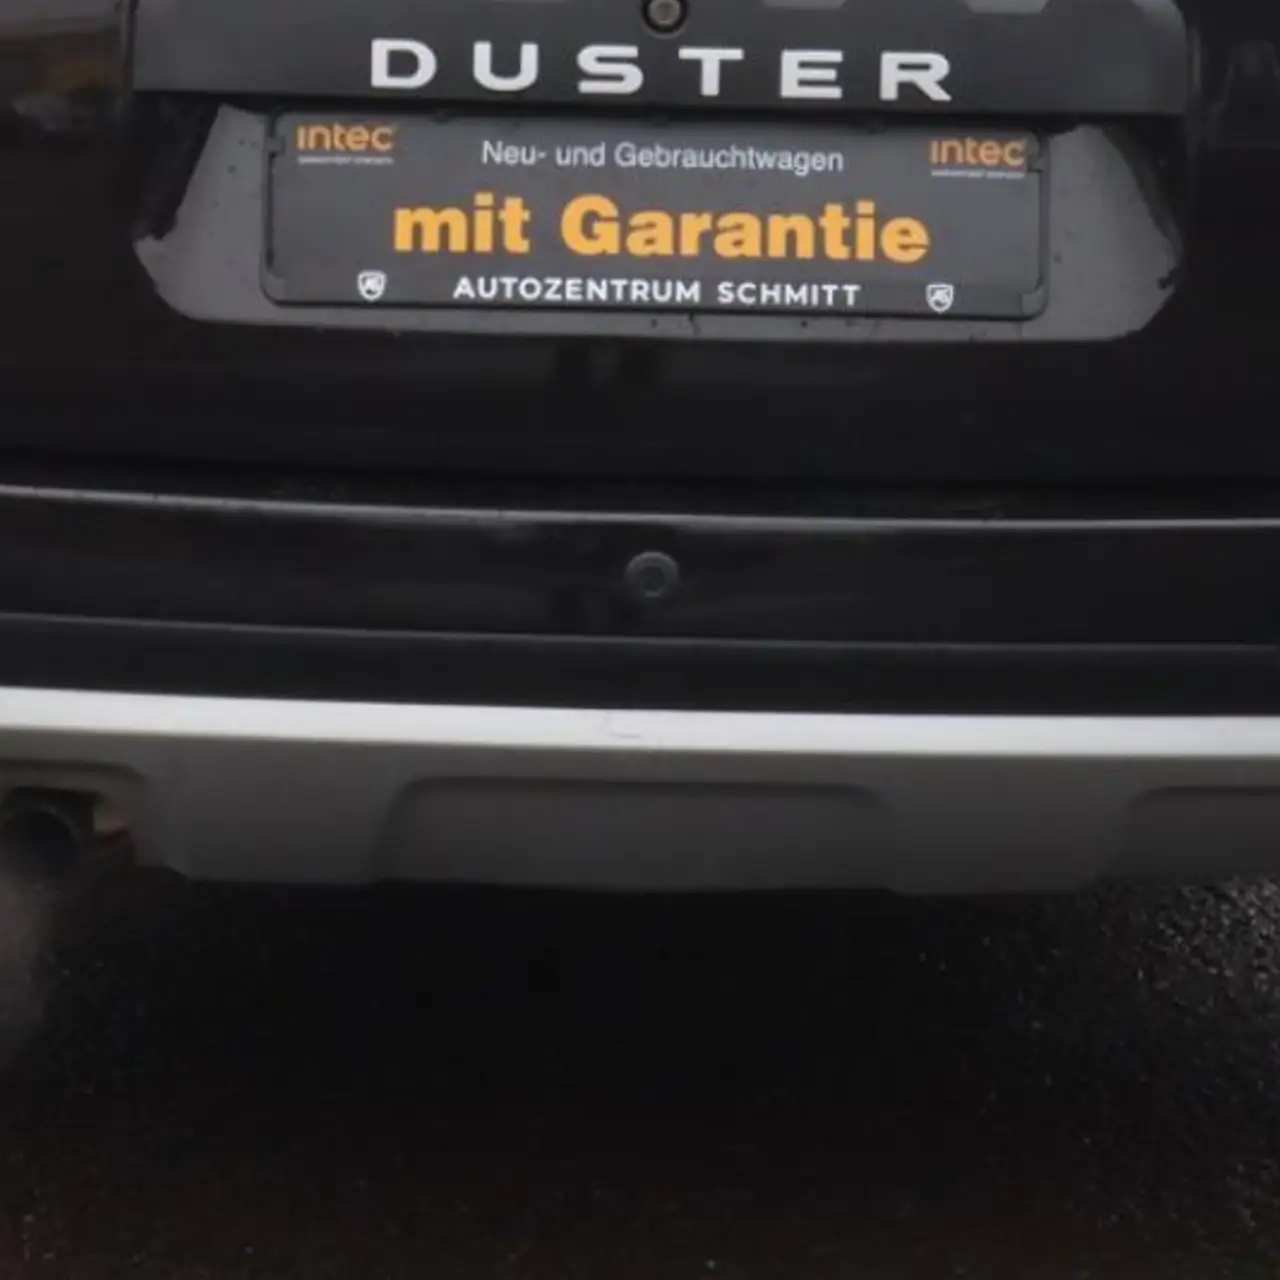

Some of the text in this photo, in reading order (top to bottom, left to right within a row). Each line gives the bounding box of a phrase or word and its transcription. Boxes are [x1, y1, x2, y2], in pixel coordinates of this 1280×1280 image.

[370, 38, 952, 102] DUSTER
[296, 122, 394, 151] intec
[929, 136, 1026, 166] intec
[482, 140, 844, 177] Neu- und Gebrauchtwagen
[394, 193, 931, 263] mit Garantie
[452, 276, 862, 307] AUTOZENTRUM SCHMITT
